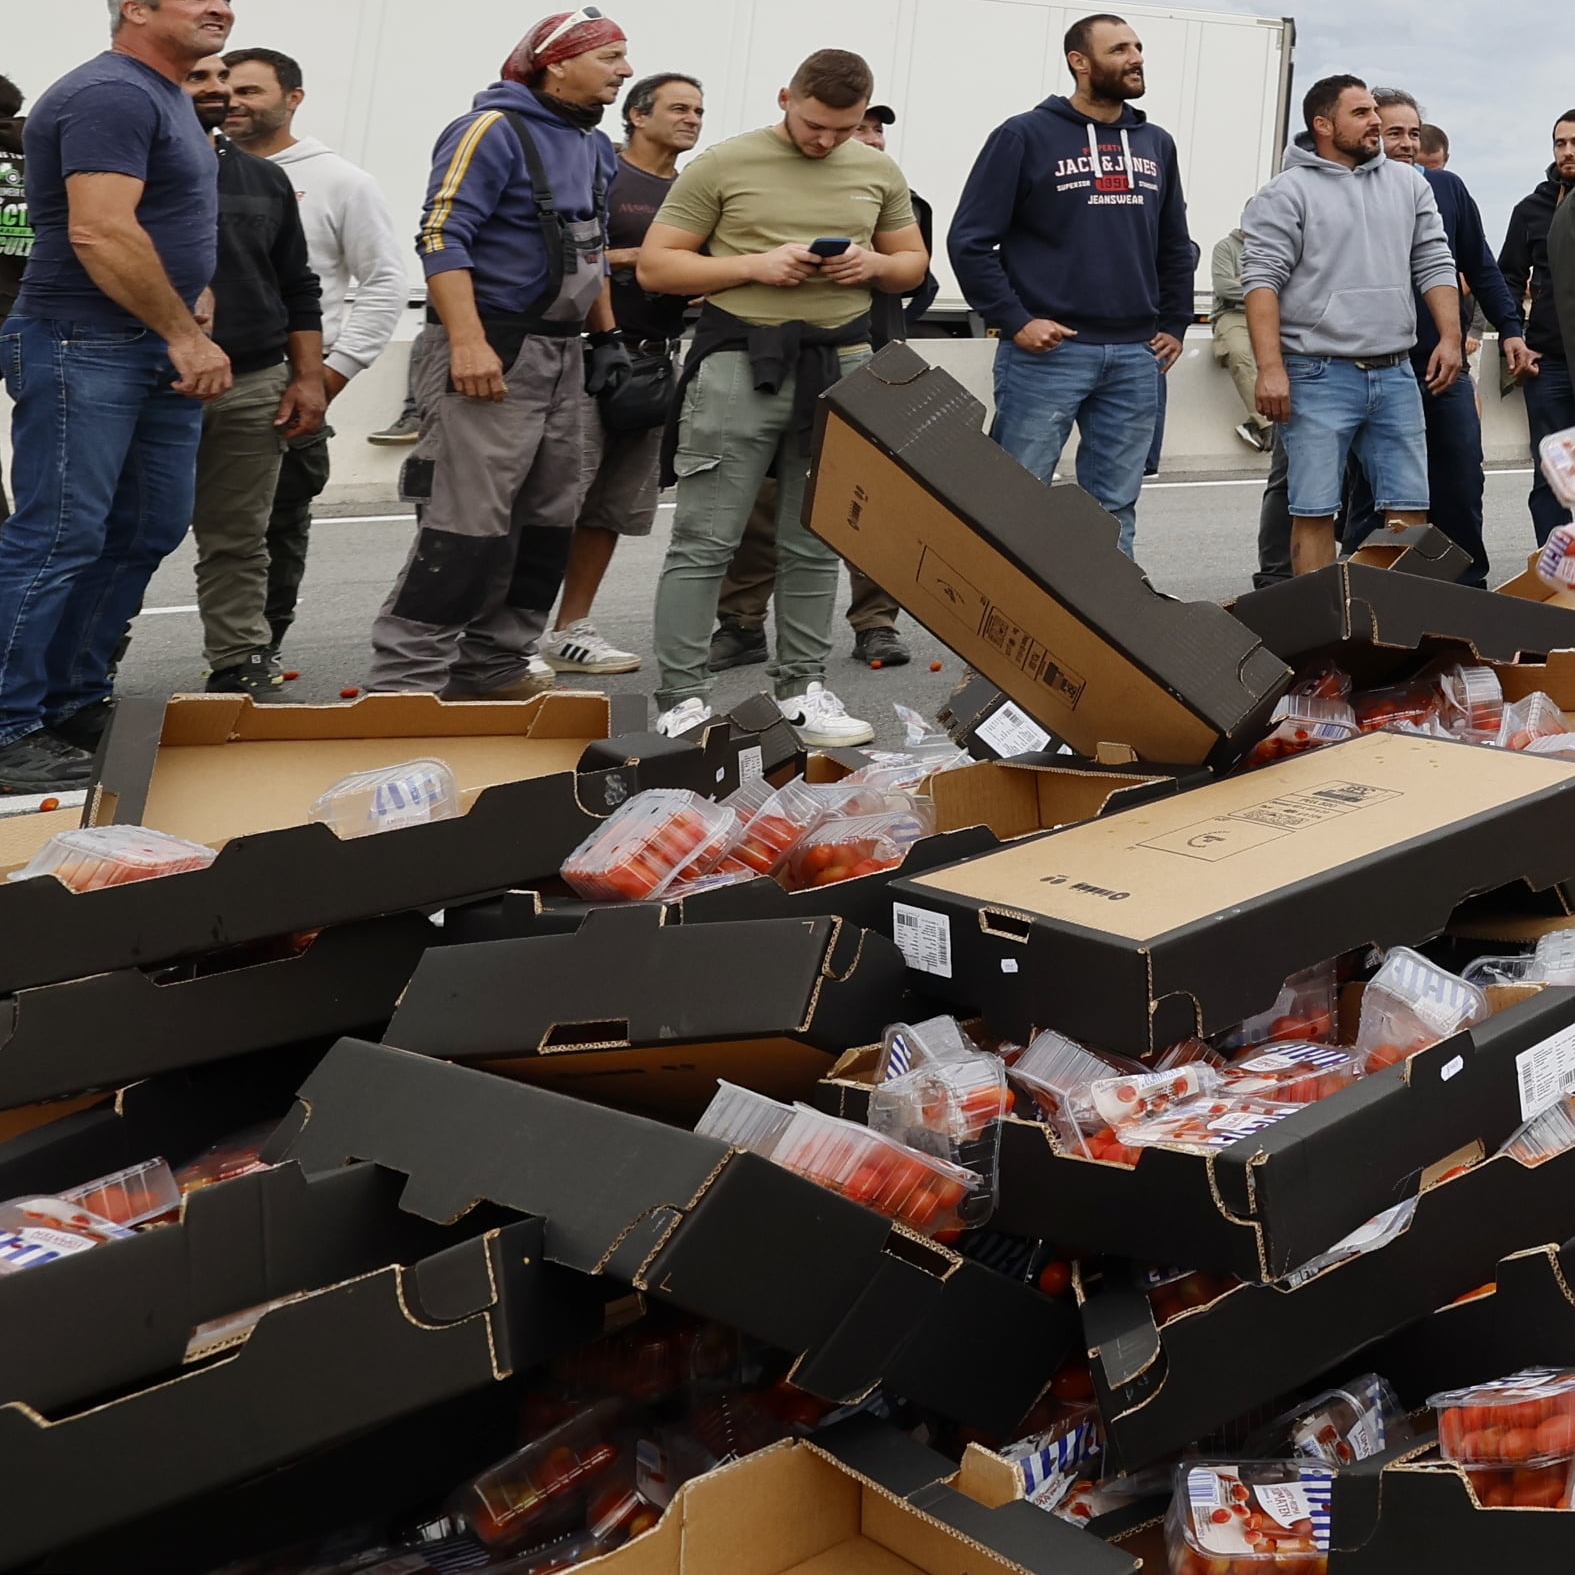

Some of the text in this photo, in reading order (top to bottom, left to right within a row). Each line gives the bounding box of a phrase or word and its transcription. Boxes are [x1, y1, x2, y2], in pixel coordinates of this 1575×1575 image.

[1099, 177, 1128, 189] 199
[1088, 194, 1144, 205] JEANSWEAR
[1358, 1427, 1370, 1457] TOMA
